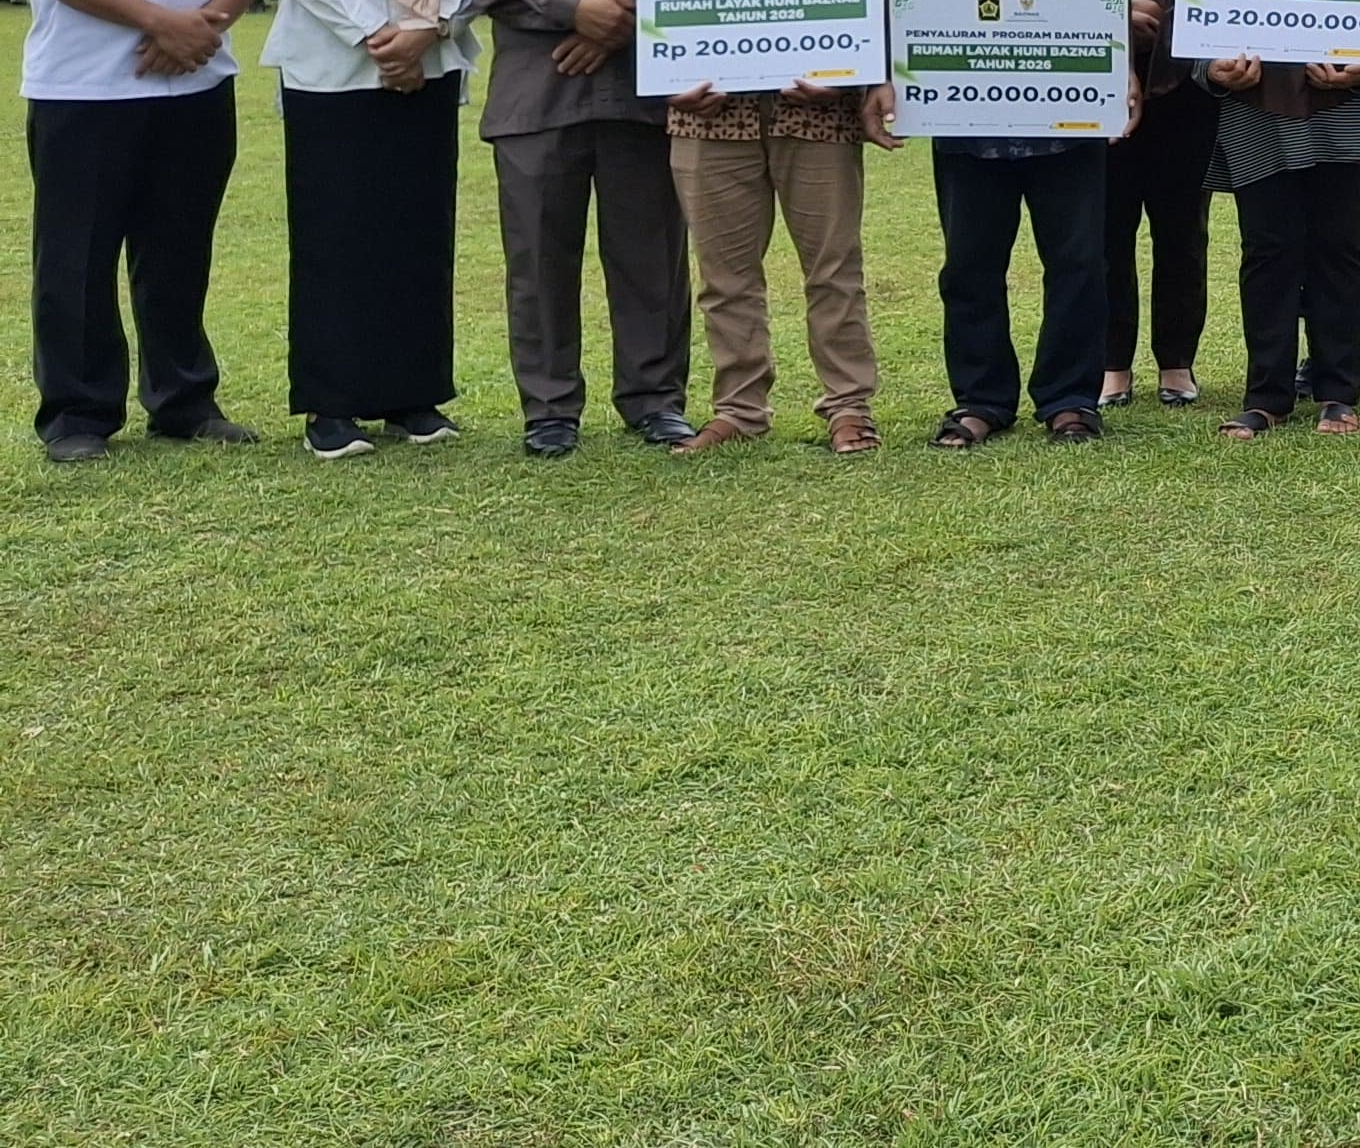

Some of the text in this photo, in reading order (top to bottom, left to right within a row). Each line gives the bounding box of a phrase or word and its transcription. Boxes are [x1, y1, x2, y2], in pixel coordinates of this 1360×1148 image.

[660, 1, 713, 12] RUMAH
[717, 9, 805, 23] TAHUN 2026
[1186, 7, 1220, 27] Rp
[905, 29, 1113, 41] PENYALURAN PROGRAM BANTUAN
[652, 33, 871, 61] Rp 20.000.000,-
[912, 45, 1106, 57] RUMAH LAYAK HUNI BAZNAS
[967, 58, 1052, 70] TAHUN 2026
[905, 85, 1116, 106] Rp 20.000.000,-
